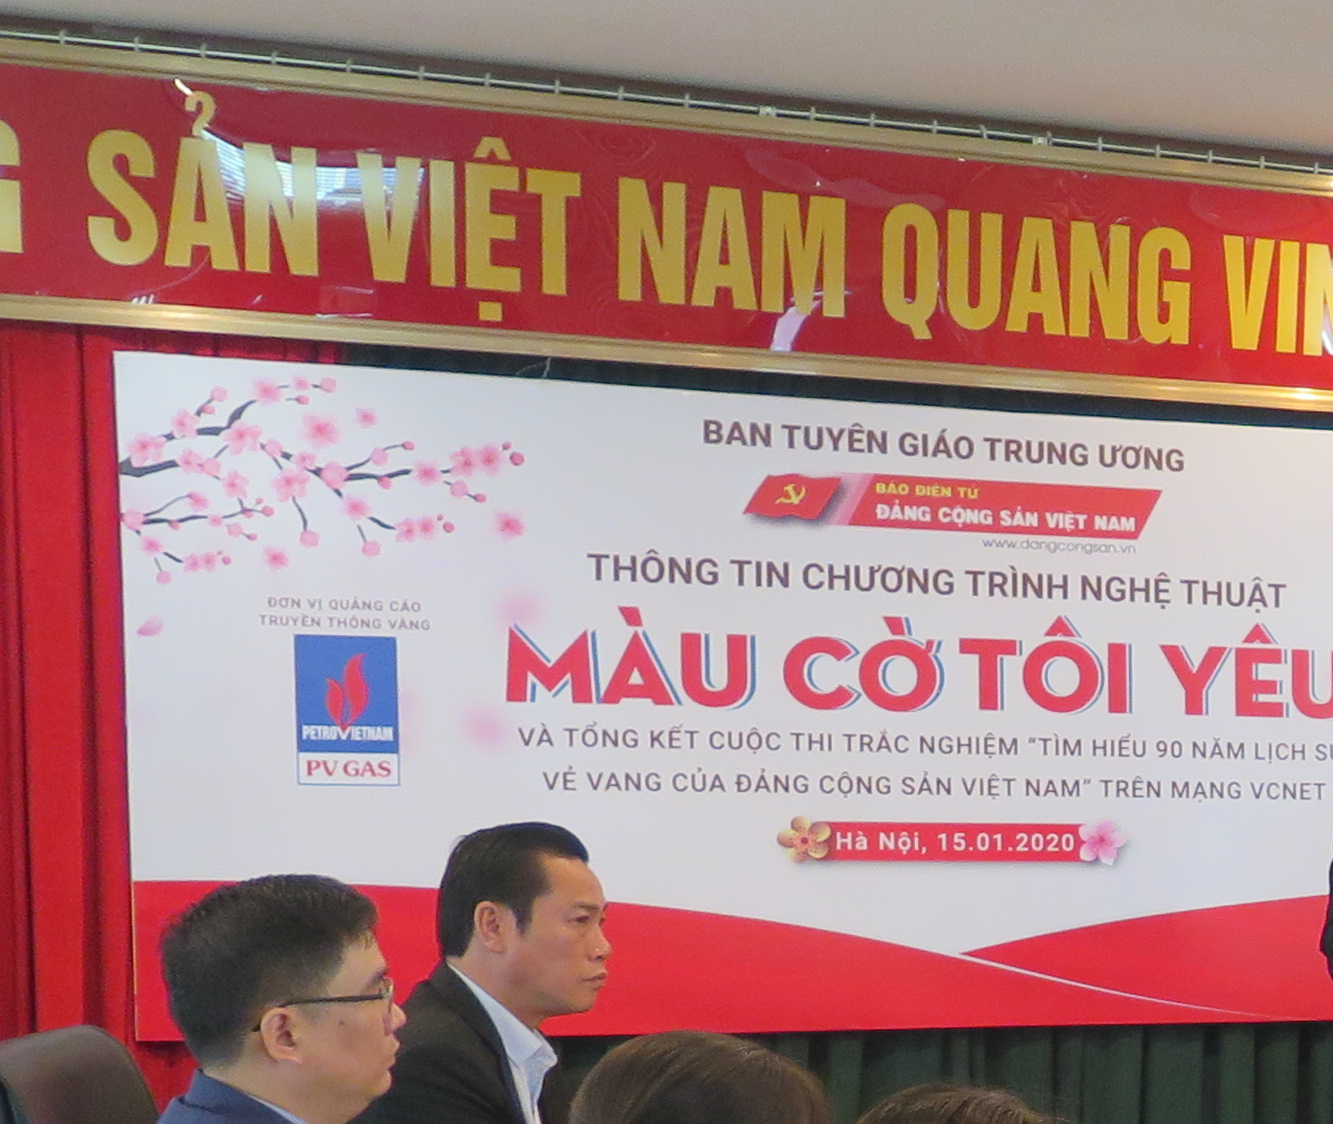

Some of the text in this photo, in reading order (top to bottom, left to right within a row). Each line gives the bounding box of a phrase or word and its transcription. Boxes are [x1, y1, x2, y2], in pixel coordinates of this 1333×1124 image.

[87, 90, 320, 278] SẢN
[355, 136, 582, 321] VIỆT
[617, 176, 847, 319] NAM
[881, 202, 1192, 345] QUANG
[702, 418, 1186, 472] BAN TUYÊN GIÁO TRUNG ƯƠNG
[875, 499, 1136, 533] ĐẢNG CỘNG SẢN VIỆT NAM
[981, 538, 1137, 555] www.dangcongsan.vn
[587, 549, 1287, 614] THÔNG TIN CHƯƠNG TRÌNH NGHỆ THUẬT
[327, 615, 382, 630] THÔNG
[389, 598, 422, 613] CÁO
[506, 606, 757, 711] MÀU
[783, 615, 945, 713] CỜ
[959, 615, 1134, 715] TÔI
[301, 725, 394, 742] PETROVIETNAM
[517, 723, 555, 748] VÀ
[562, 720, 640, 749] TỔNG
[649, 723, 700, 750] KẾT
[708, 727, 782, 756] CUỘC
[789, 731, 833, 753] THI
[842, 729, 910, 756] TRẮC
[919, 731, 1019, 759] NGHIỆM
[1092, 732, 1147, 759] HIỂU
[1155, 740, 1184, 760] 90
[1191, 737, 1246, 761] NĂM
[1253, 741, 1307, 766] LỊCH
[306, 759, 393, 778] PV GAS
[542, 765, 578, 792] VẺ
[586, 771, 662, 793] VANG
[672, 766, 726, 794] CỦA
[734, 767, 810, 795] ĐẢNG
[818, 771, 892, 799] CỘNG
[901, 769, 953, 797] SẢN
[961, 773, 1017, 800] VIỆT
[1098, 774, 1162, 799] TRÊN
[1170, 780, 1242, 803] MẠNG
[1249, 781, 1327, 801] VCNET
[835, 830, 1076, 861] Hà Nội, 15.01.2020
